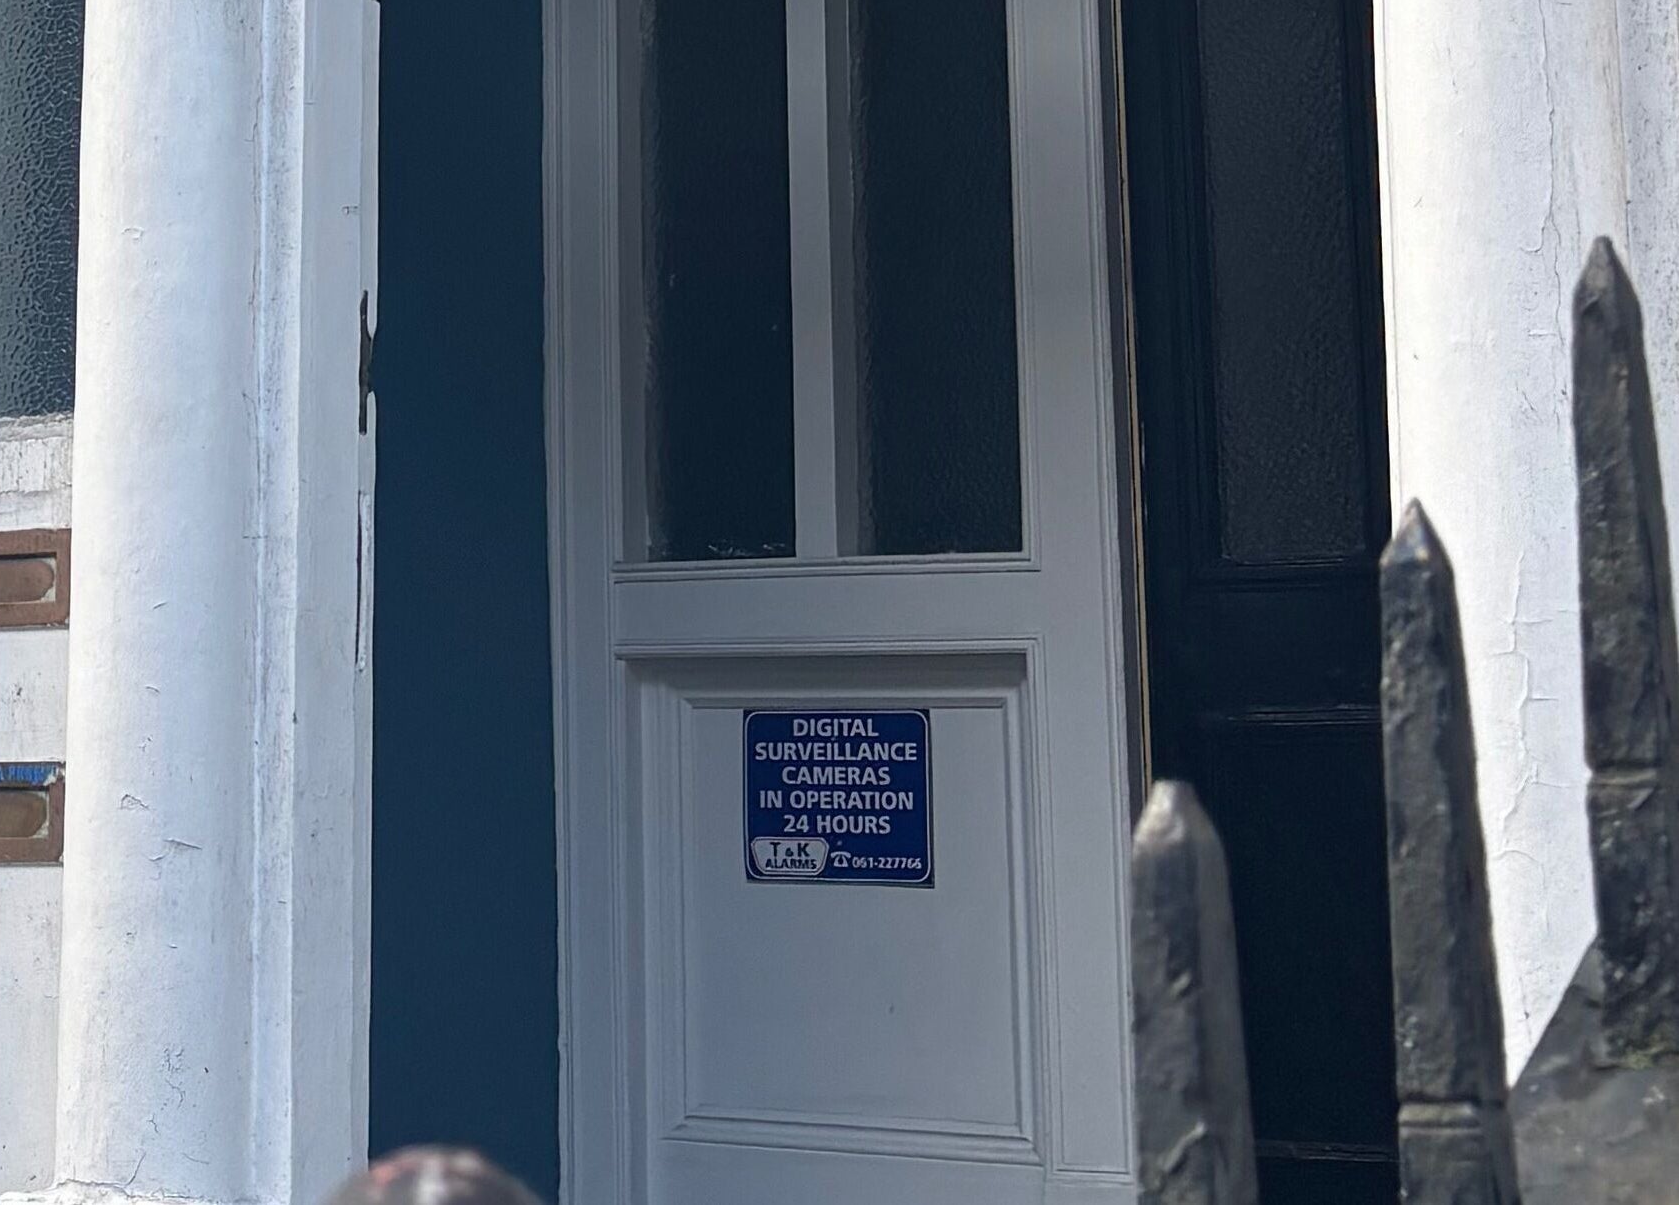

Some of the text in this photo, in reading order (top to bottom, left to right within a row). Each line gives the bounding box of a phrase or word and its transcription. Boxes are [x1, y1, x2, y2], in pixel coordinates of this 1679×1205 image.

[792, 718, 879, 737] DIGITAL
[754, 742, 918, 761] SURVEILLANCE
[782, 766, 891, 785] CAMERAS
[759, 790, 914, 810] IN OPERATION
[783, 814, 891, 834] 24 HOURS
[769, 842, 781, 857] T
[798, 842, 810, 857] K
[765, 859, 818, 870] ALARMS
